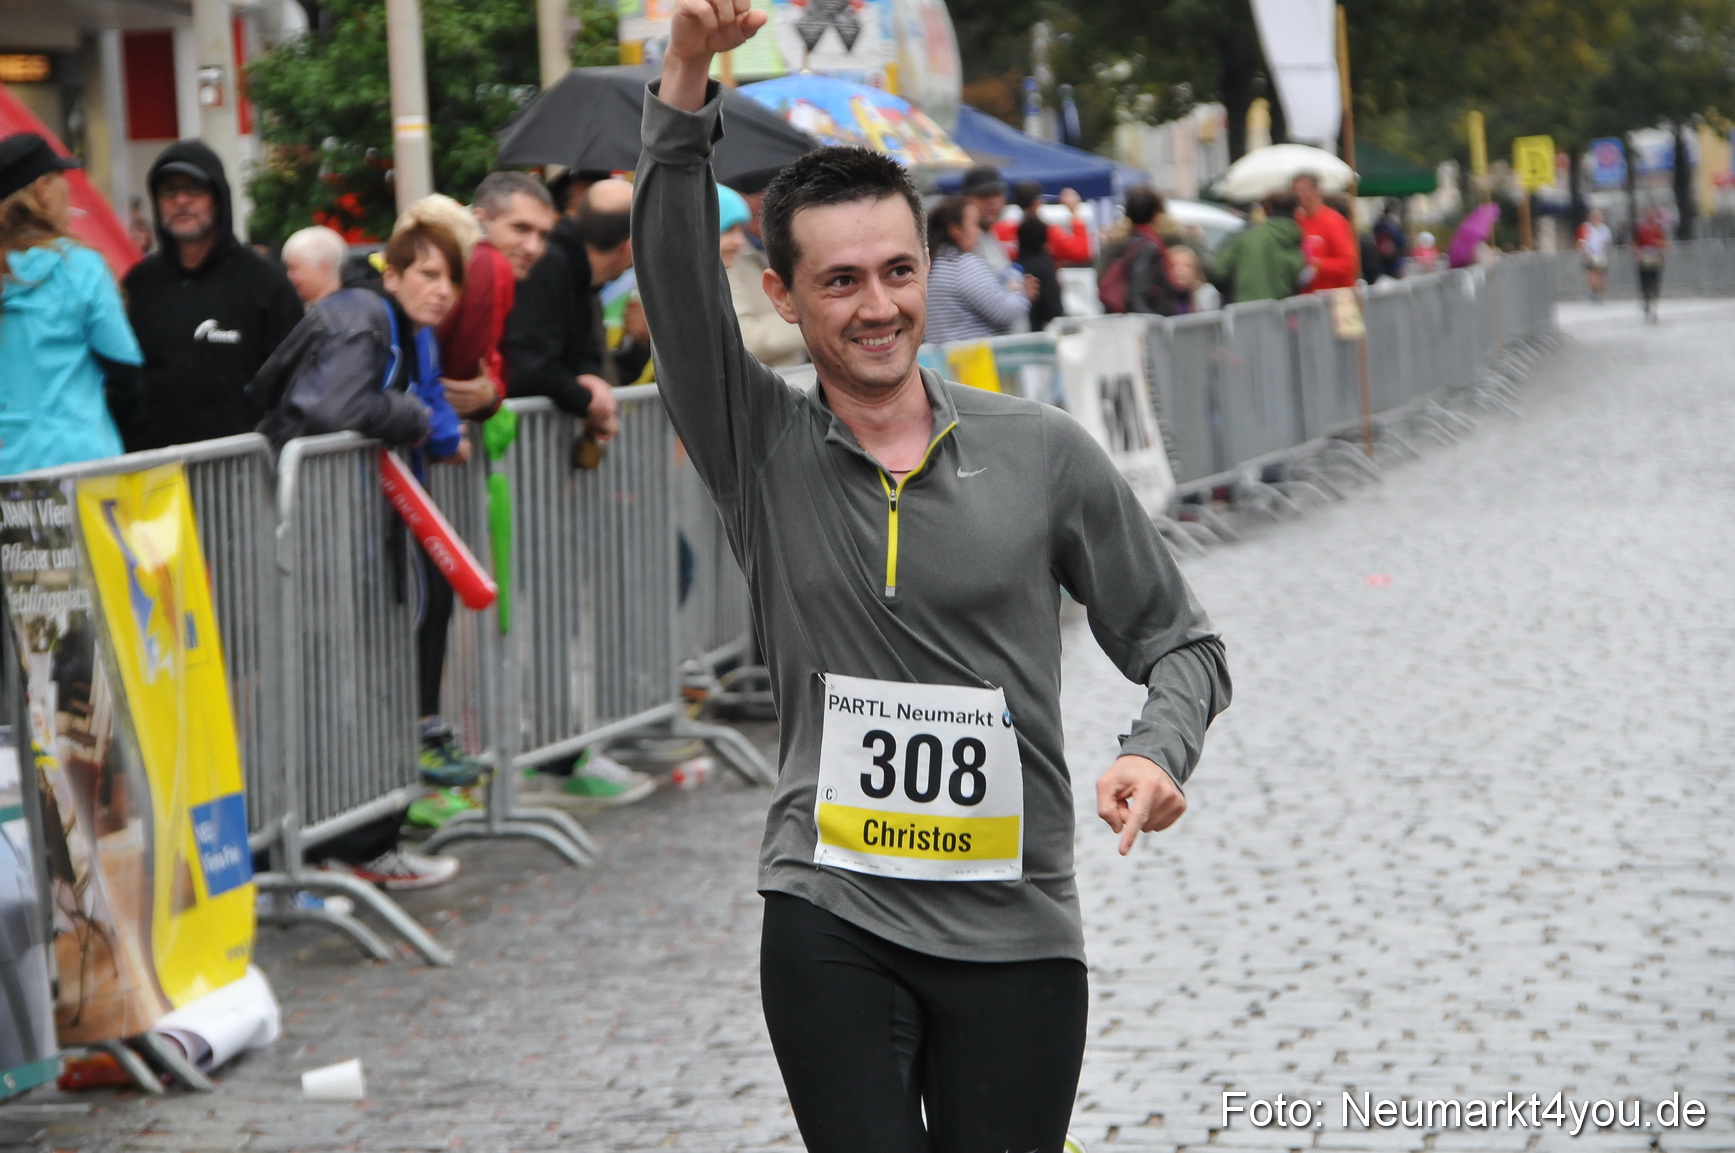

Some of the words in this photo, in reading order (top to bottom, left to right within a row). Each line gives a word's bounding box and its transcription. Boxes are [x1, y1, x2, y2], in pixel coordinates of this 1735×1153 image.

[828, 694, 891, 718] PARTL
[897, 703, 994, 727] Neumarkt
[860, 729, 987, 807] 308
[863, 819, 972, 852] Christos
